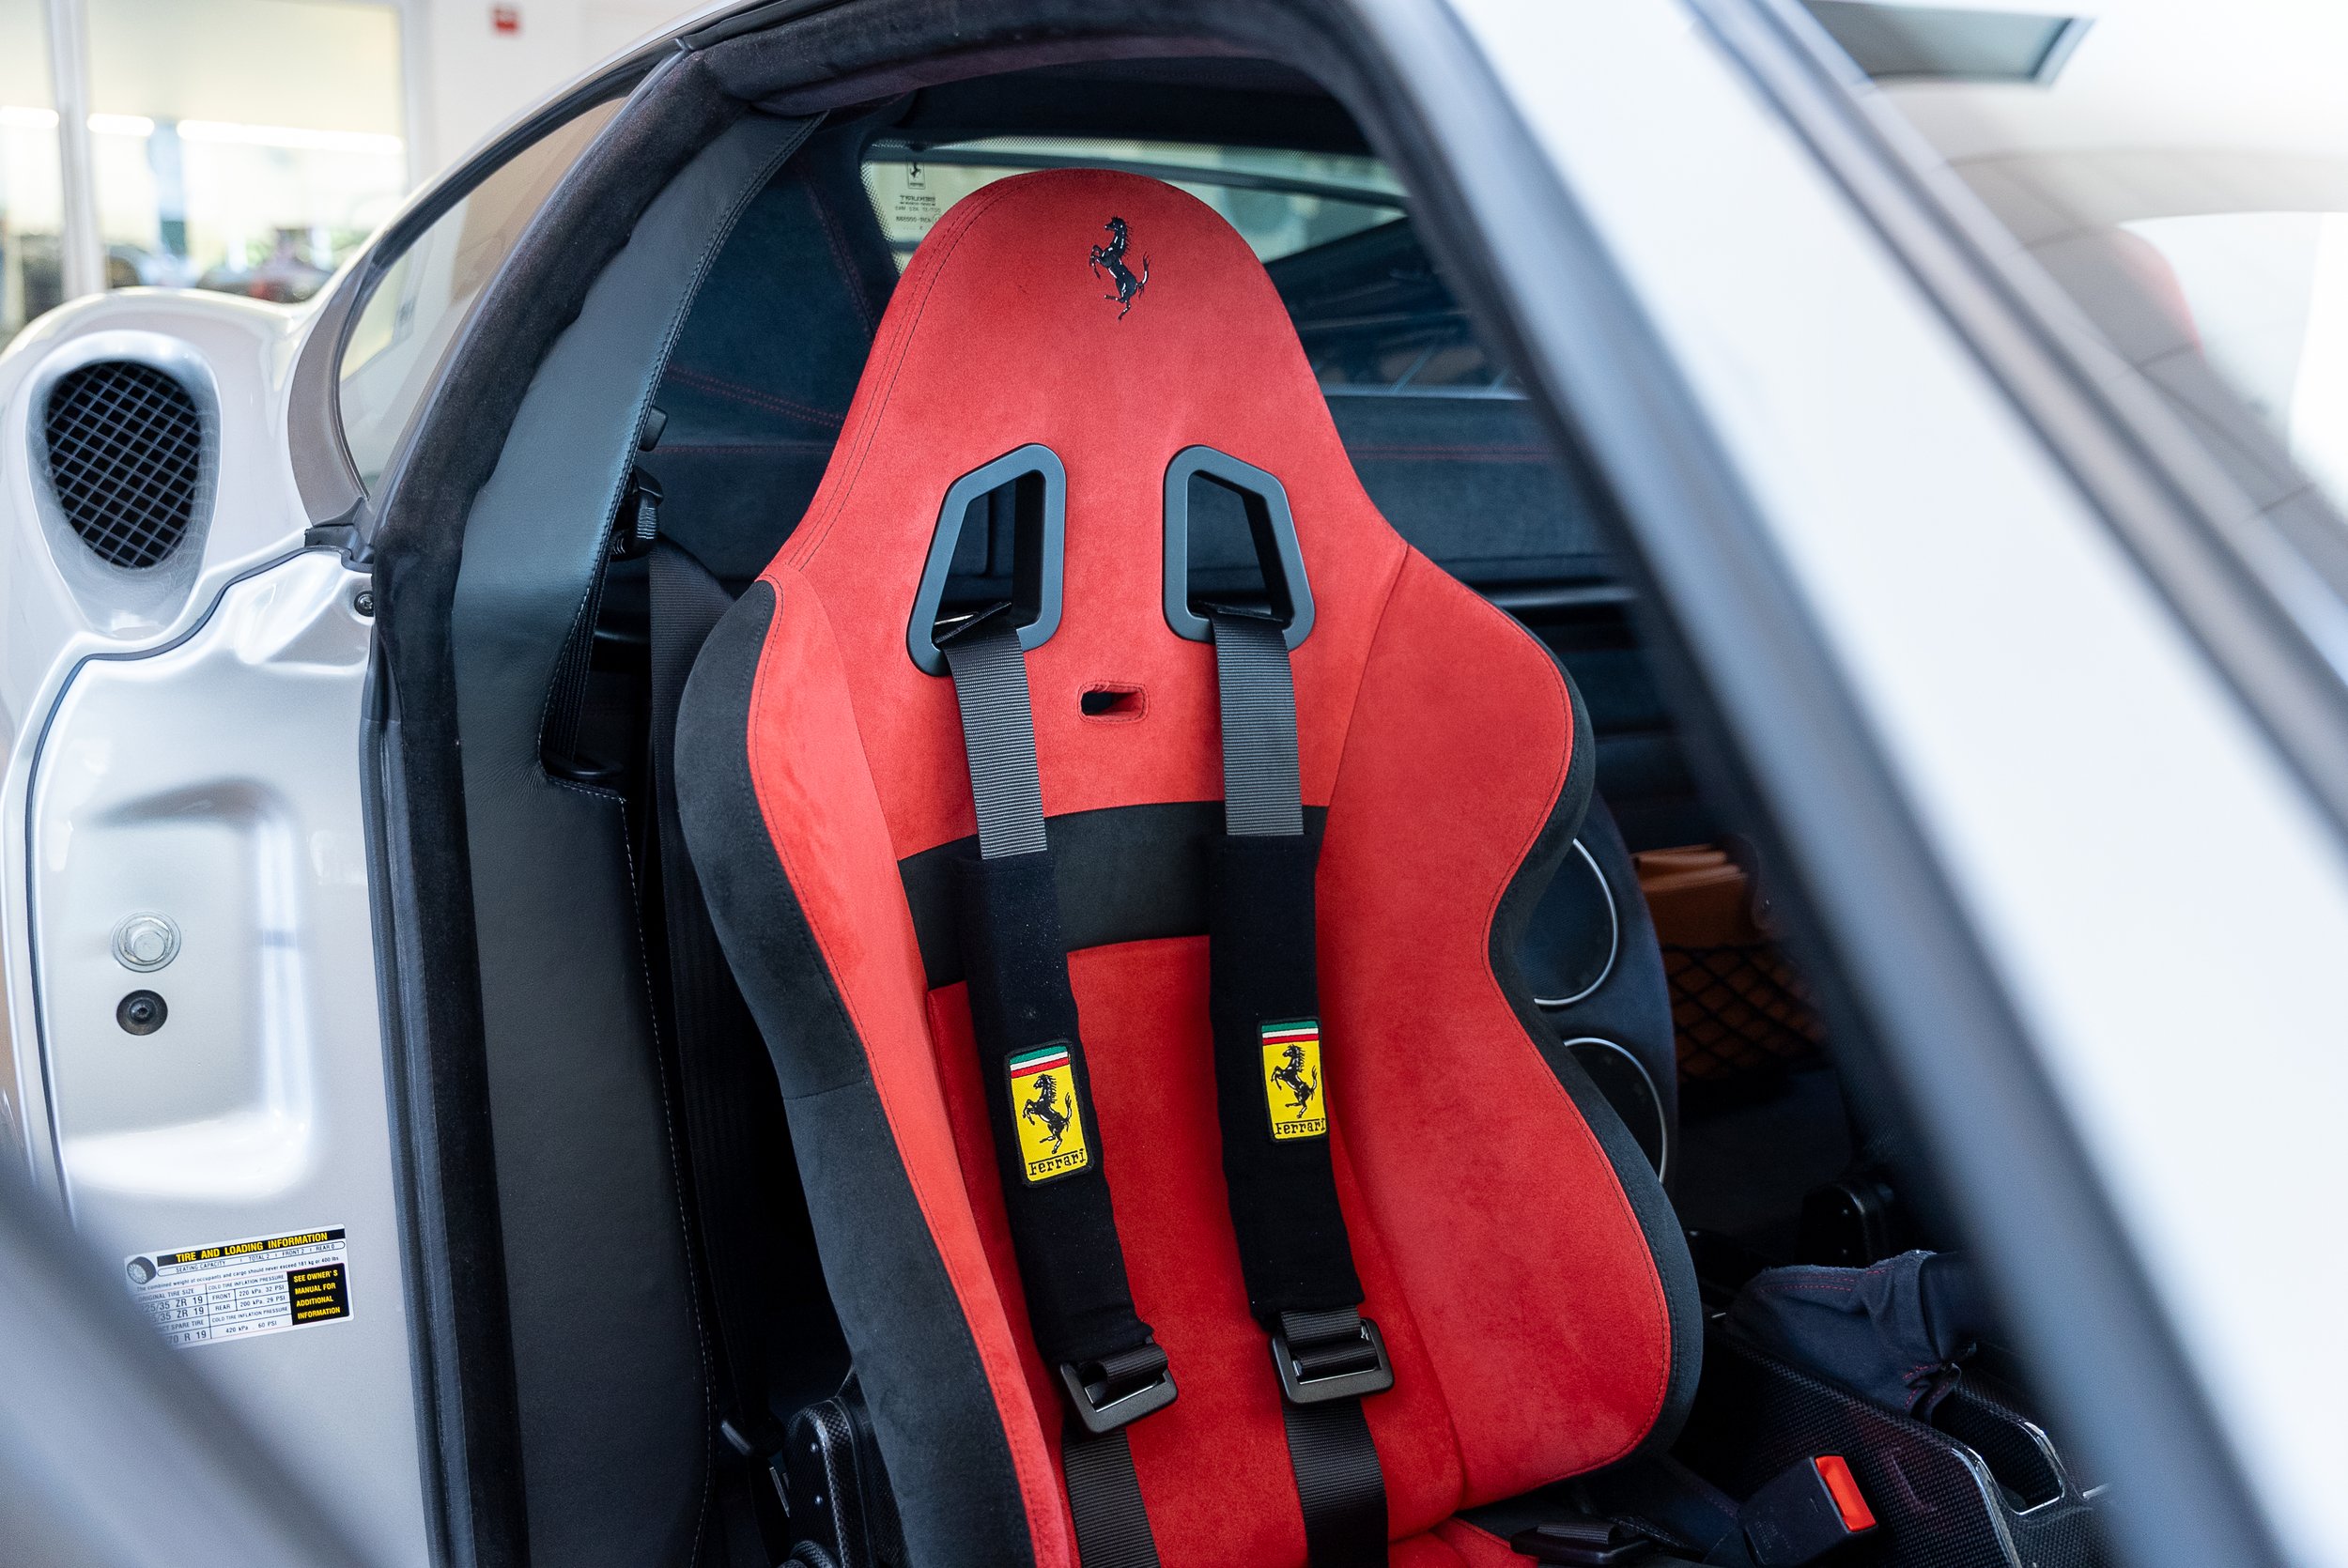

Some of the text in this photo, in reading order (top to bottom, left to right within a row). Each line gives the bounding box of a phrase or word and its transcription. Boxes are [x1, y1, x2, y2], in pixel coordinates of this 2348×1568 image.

[1275, 1118, 1326, 1135] Ferrari
[1028, 1148, 1087, 1176] Ferrari
[176, 1232, 328, 1263] TIRE AND LOADING INFORMATION
[248, 1253, 265, 1262] TOTAL
[176, 1261, 225, 1273] SEATING CAPACITY
[293, 1273, 305, 1284] SEE
[147, 1282, 172, 1290] combined
[294, 1282, 336, 1295] MANUAL FOR
[176, 1298, 187, 1308] ZR
[193, 1295, 203, 1305] 19
[212, 1292, 231, 1300] FRONT
[296, 1295, 334, 1308] ADDITIONAL
[177, 1309, 189, 1319] ZR
[194, 1306, 205, 1316] 19
[263, 1306, 287, 1314] PRESSURE
[297, 1306, 341, 1320] INFORMATION
[184, 1333, 191, 1342] R
[196, 1330, 207, 1340] 19
